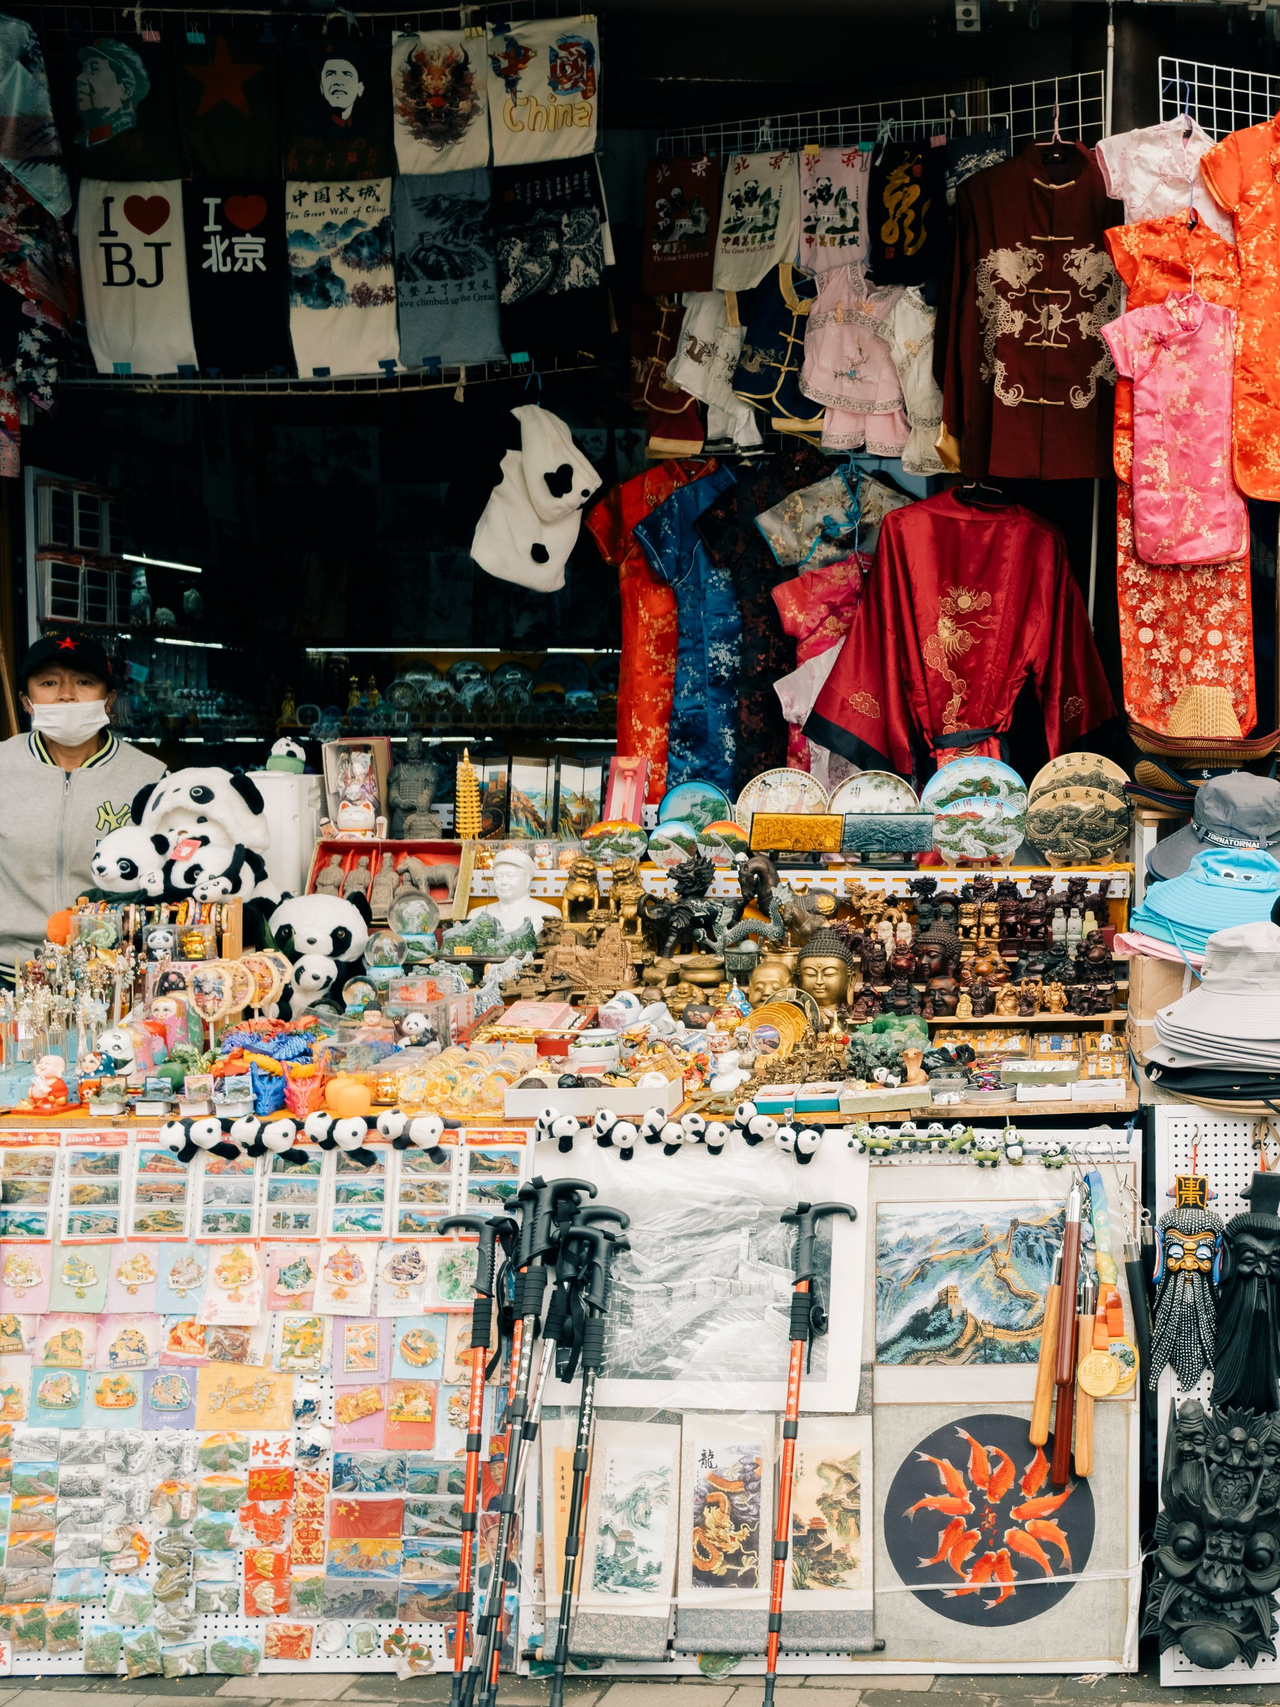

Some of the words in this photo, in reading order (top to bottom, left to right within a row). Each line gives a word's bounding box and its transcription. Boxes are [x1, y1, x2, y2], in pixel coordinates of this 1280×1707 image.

[503, 93, 593, 132] China
[656, 156, 711, 183] 北京
[733, 151, 790, 175] 北京
[292, 183, 382, 207] 中国长城
[98, 196, 118, 237] I
[202, 197, 222, 233] I
[330, 206, 348, 216] Wall
[353, 206, 362, 217] of
[202, 232, 267, 273] 北京
[99, 242, 172, 288] BJ
[416, 297, 449, 307] climbed
[473, 292, 495, 302] Great
[952, 798, 1004, 811] 中国长城
[1051, 789, 1106, 802] 中国长城
[252, 1436, 292, 1458] 北京
[342, 1437, 375, 1445] BEIJING
[697, 1449, 718, 1469] 龍
[250, 1471, 290, 1492] 北京
